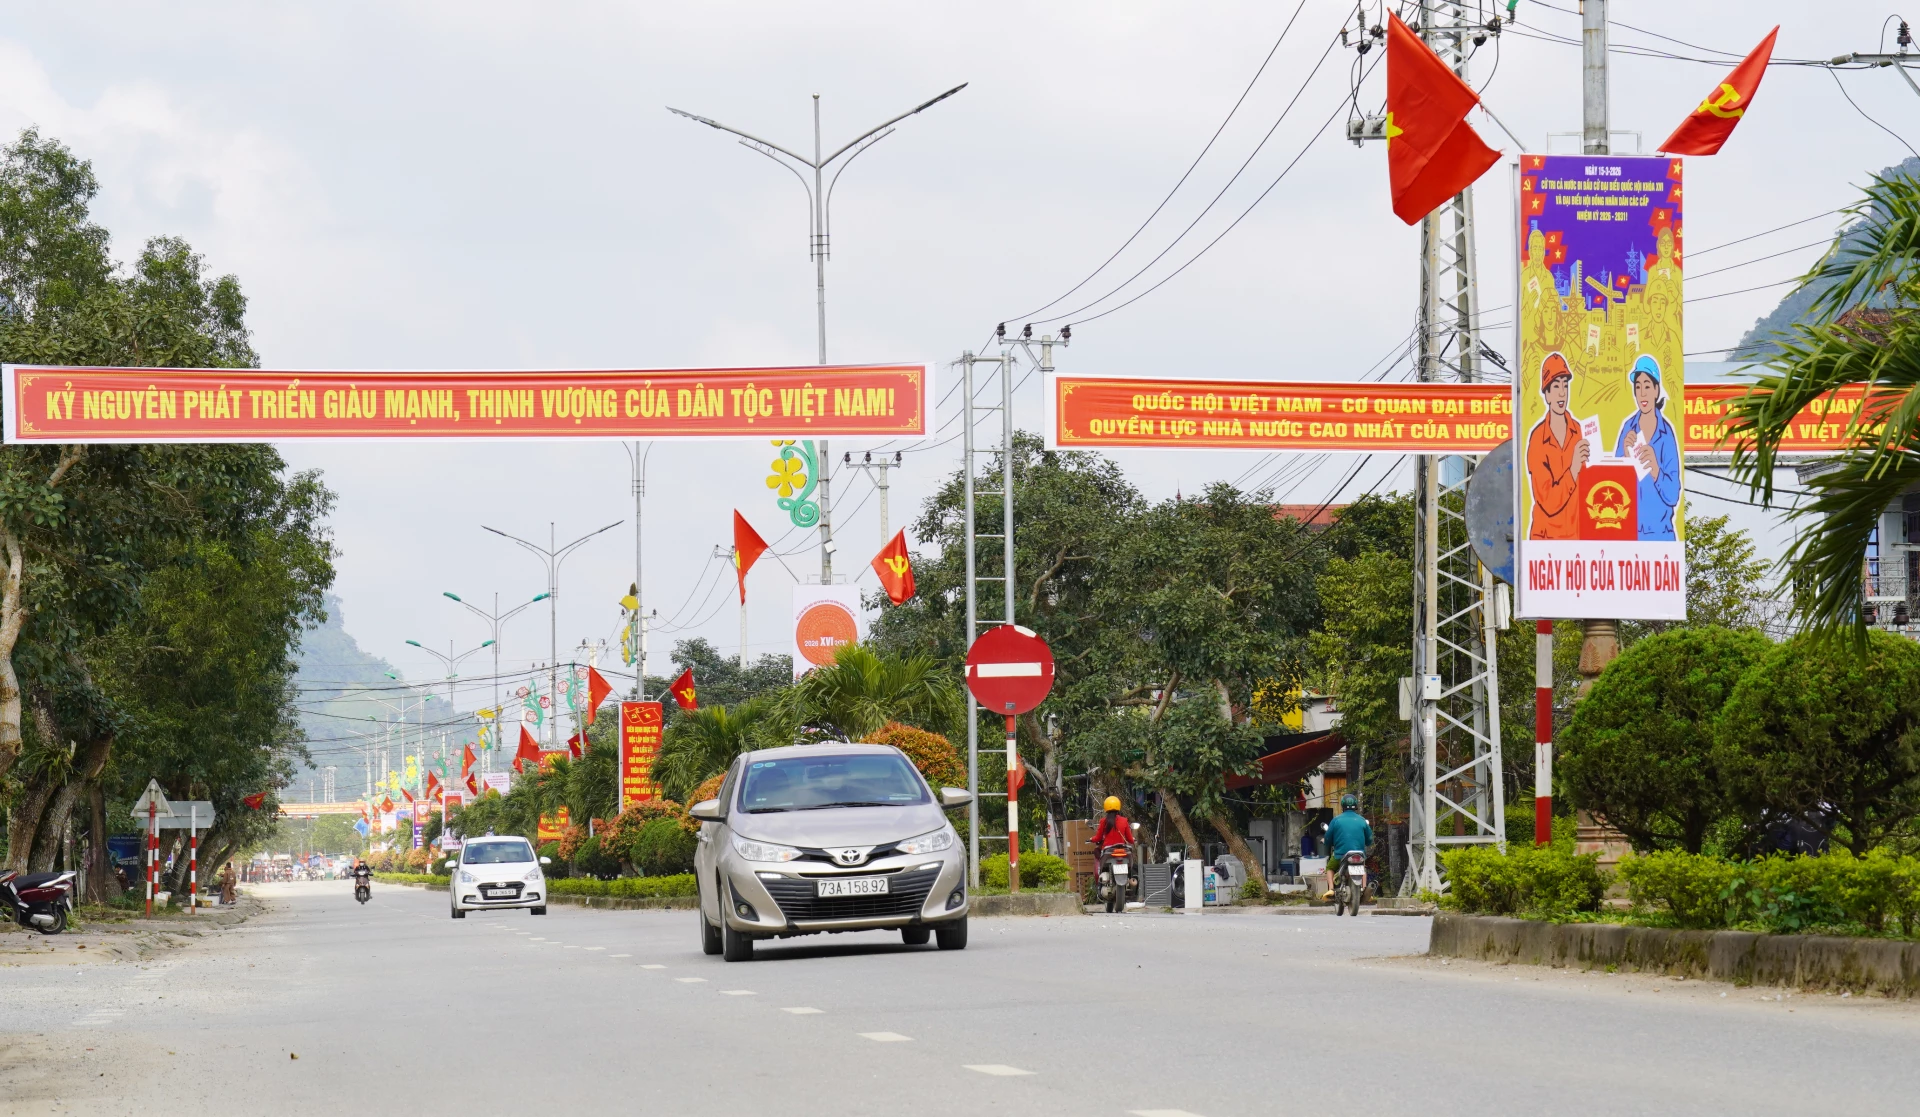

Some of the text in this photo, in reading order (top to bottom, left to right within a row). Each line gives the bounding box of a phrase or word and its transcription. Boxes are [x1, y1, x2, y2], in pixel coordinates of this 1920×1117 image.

[46, 378, 895, 425] KỶ NGUYÊN PHÁT TRIỂN GIÀU MẠNH, THỊNH VƯỢNG CỦA DÂN TỘC VIỆT NAM!
[1132, 390, 1185, 412] QUỐC
[1190, 393, 1226, 415] HỘI
[1229, 393, 1271, 415] VIỆT
[1275, 396, 1322, 413] NAM
[1341, 397, 1369, 414] CƠ
[1373, 398, 1427, 415] QUAN
[1431, 399, 1465, 417] ĐẠI
[1470, 393, 1513, 415] BIỂU
[1683, 396, 1721, 415] HÂN
[1088, 413, 1509, 440] QUYỀN LỰC NHÀ NƯỚC CAO NHẤT CỦA NƯỚC
[1799, 421, 1841, 442] VIỆT
[1528, 550, 1680, 598] NGÀY HỘI CỦA TOÀN DÂN
[820, 636, 834, 647] XVI
